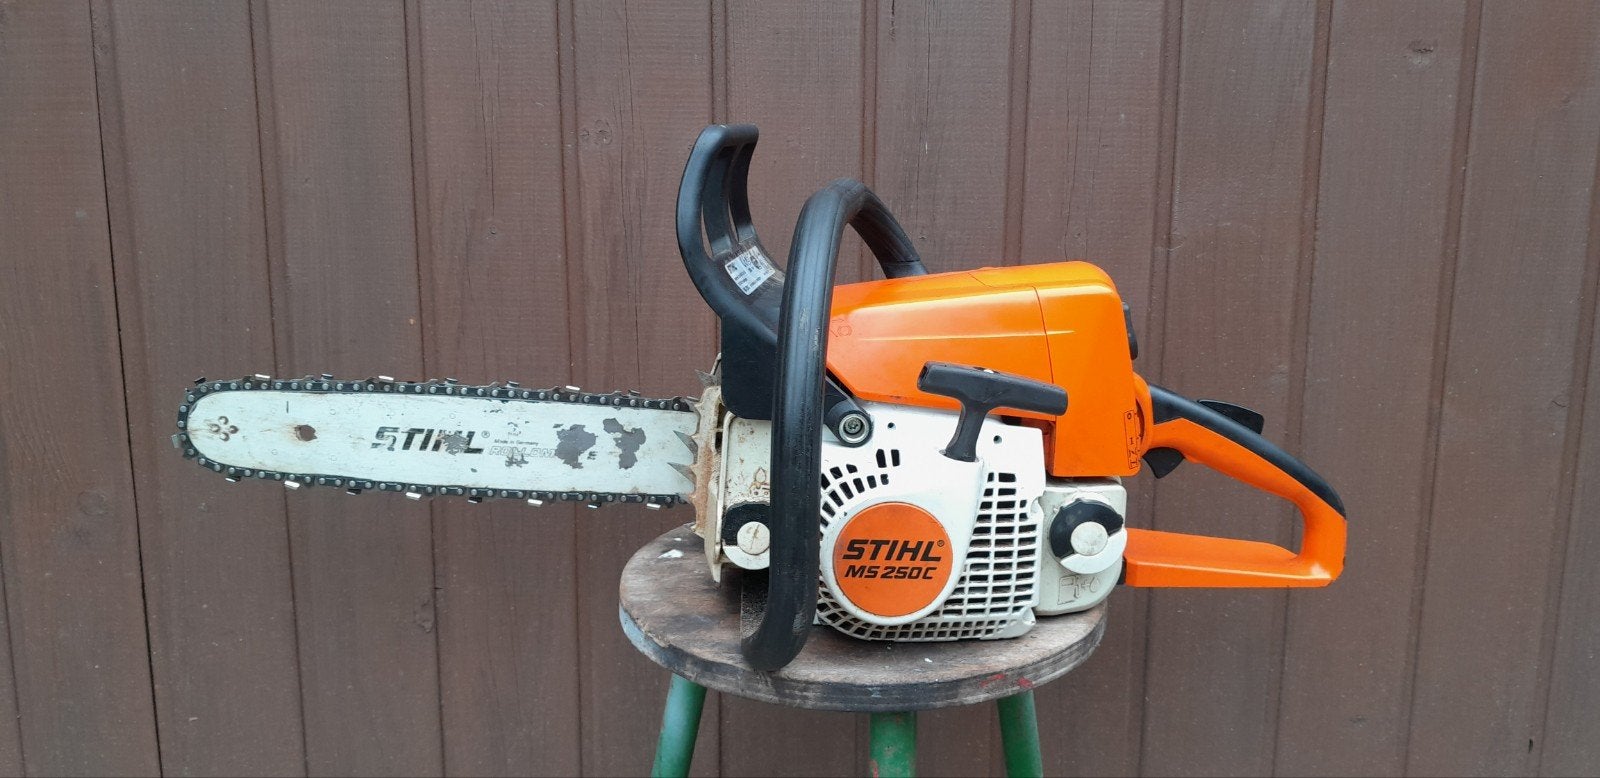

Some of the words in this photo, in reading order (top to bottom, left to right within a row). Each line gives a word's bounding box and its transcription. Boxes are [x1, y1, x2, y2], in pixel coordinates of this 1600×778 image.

[842, 539, 941, 562] STIHL
[844, 565, 880, 579] MS
[880, 566, 937, 580] 250C
